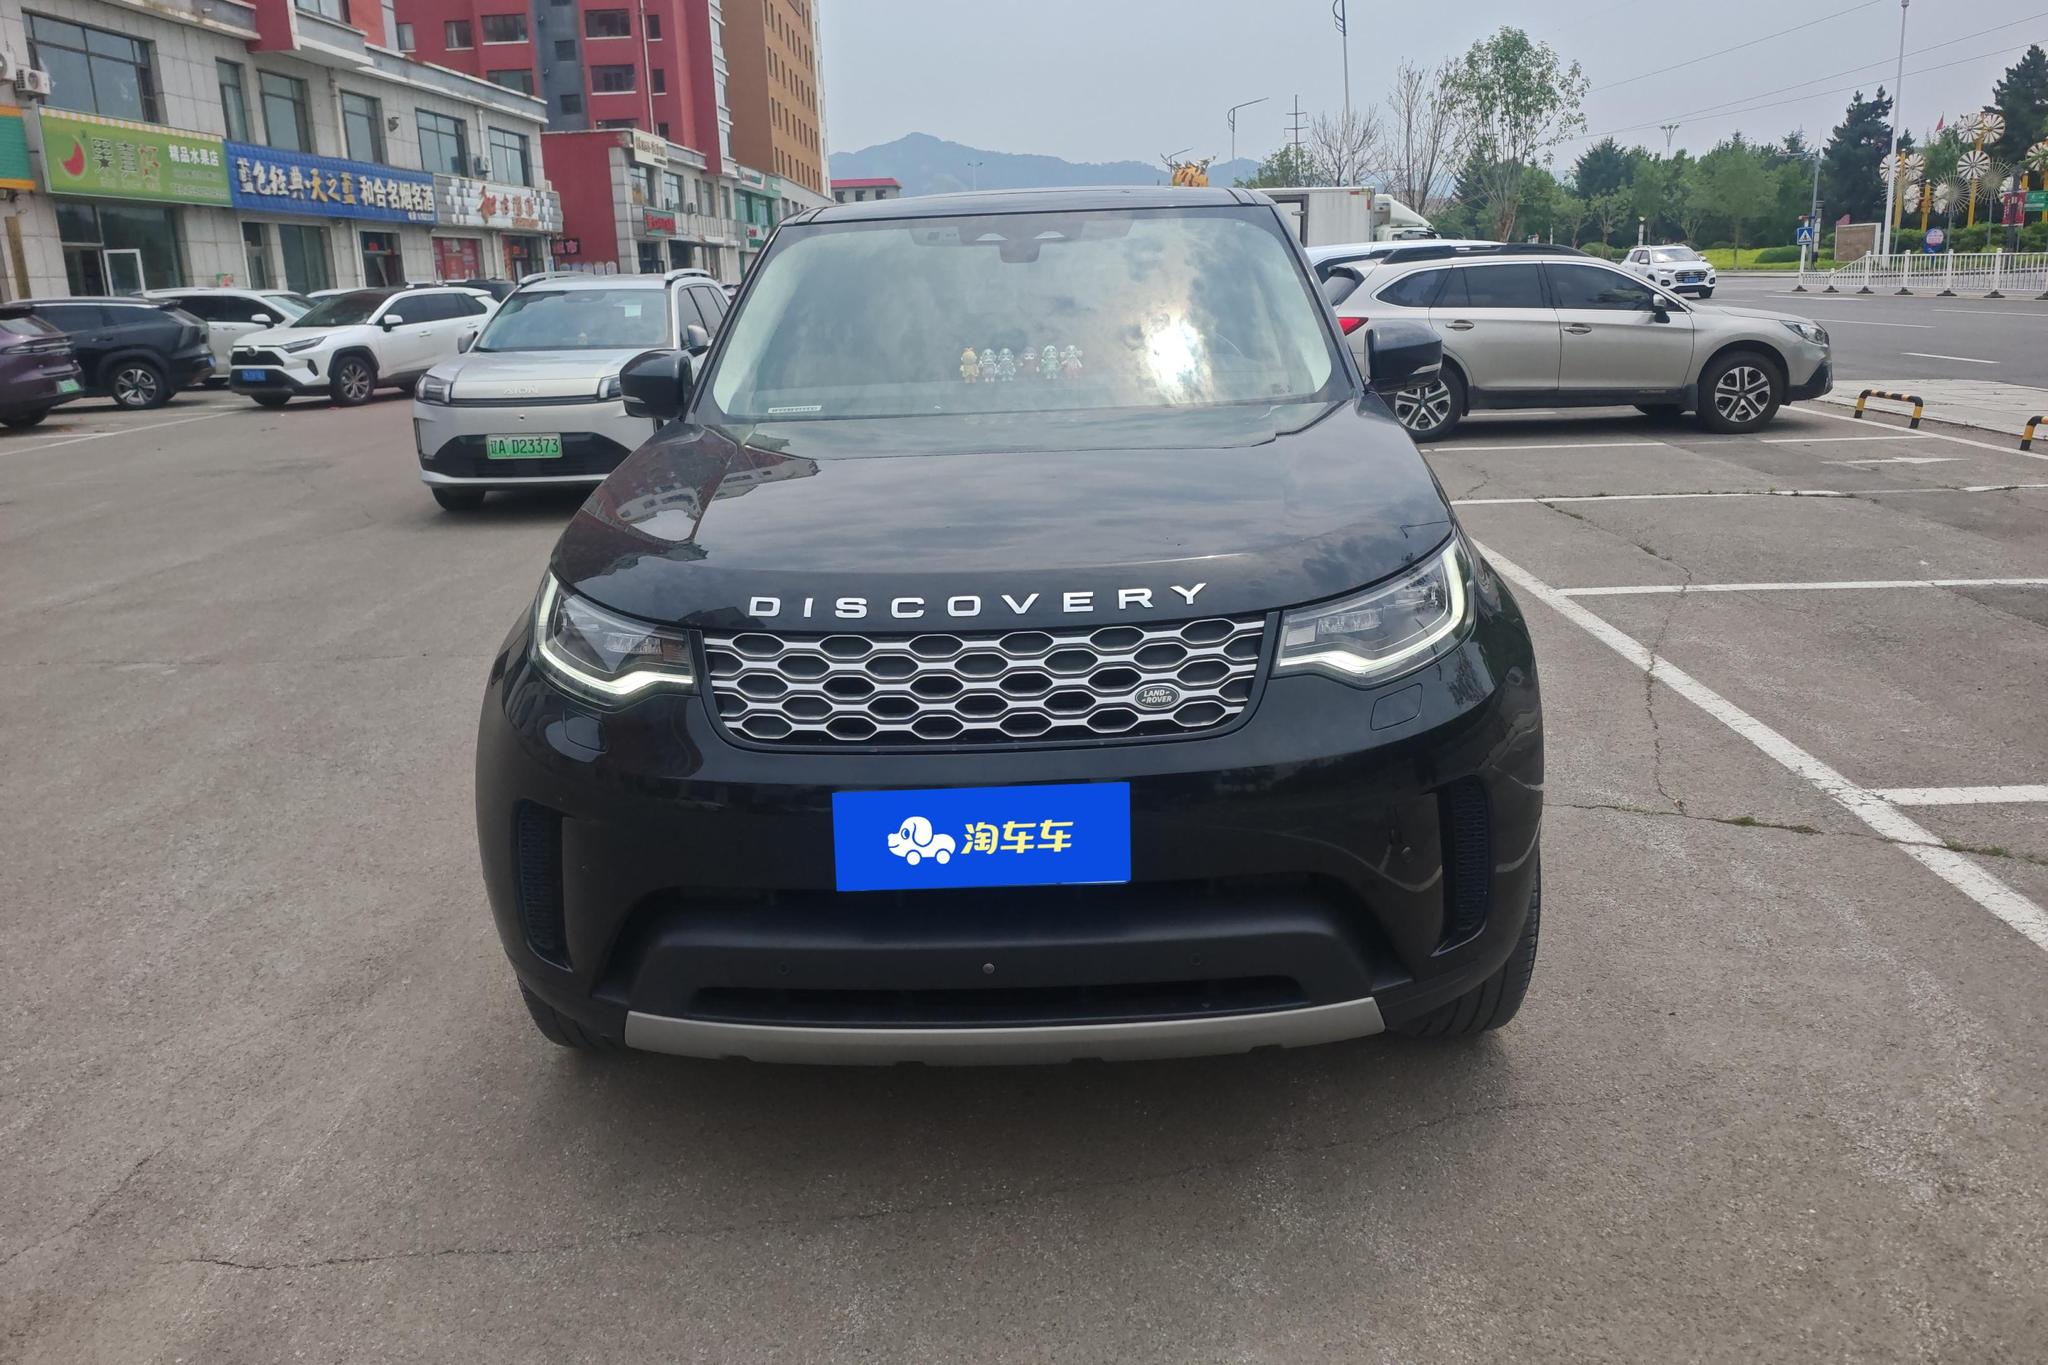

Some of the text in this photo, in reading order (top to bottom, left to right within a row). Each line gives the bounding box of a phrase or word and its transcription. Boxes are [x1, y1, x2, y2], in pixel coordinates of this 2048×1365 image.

[168, 144, 220, 167] 精品水果店
[503, 385, 539, 395] AION
[748, 583, 1207, 618] DISCOVERY
